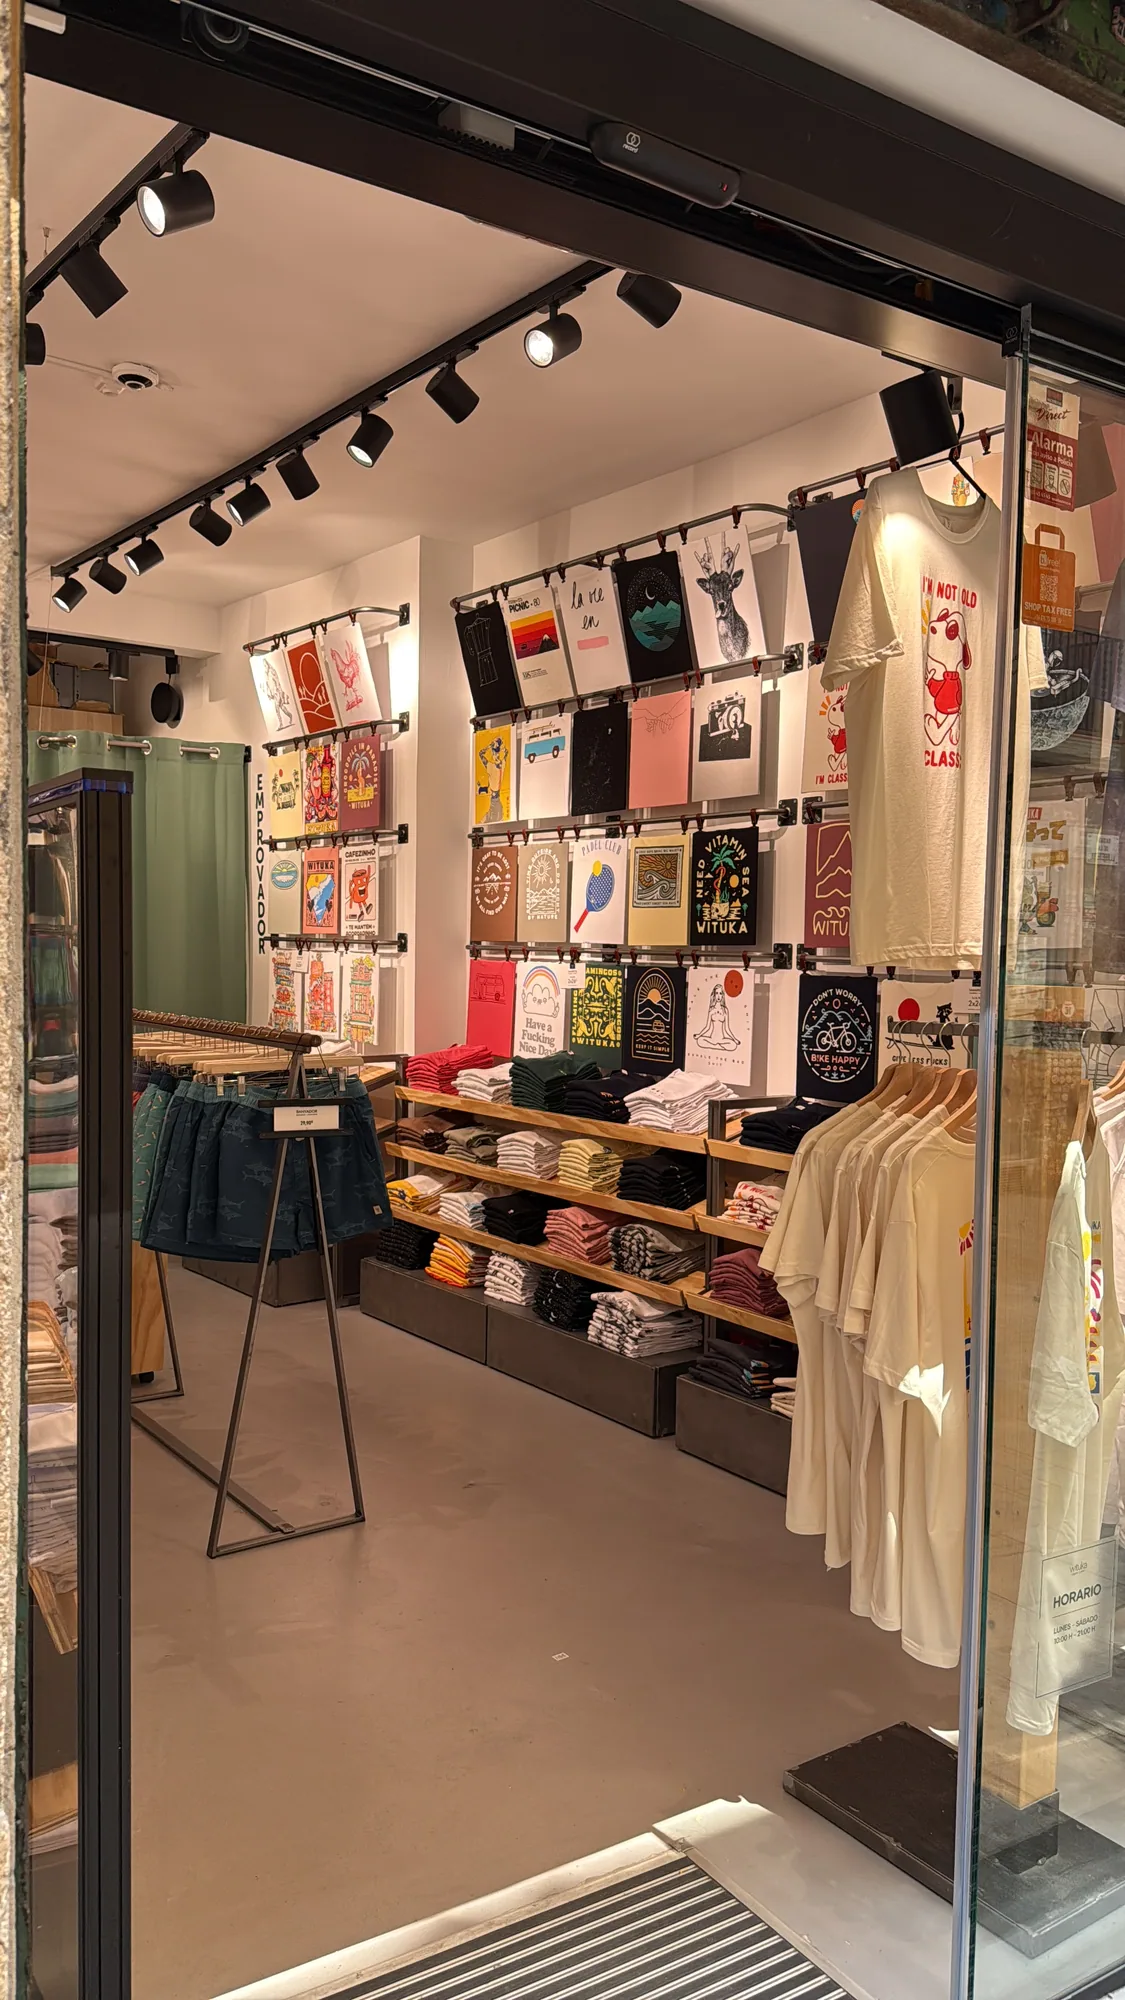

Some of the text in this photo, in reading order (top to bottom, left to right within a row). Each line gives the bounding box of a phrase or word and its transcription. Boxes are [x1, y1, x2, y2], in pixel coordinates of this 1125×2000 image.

[622, 143, 638, 154] record
[1037, 408, 1072, 420] Direct
[1032, 432, 1073, 458] Alarma
[570, 580, 584, 609] la
[923, 576, 977, 608] I'M NOT OLD
[508, 600, 529, 613] PICNIC
[1024, 601, 1072, 617] SHOP TAX FREE
[582, 615, 599, 630] en
[924, 750, 961, 769] CLASS
[816, 775, 824, 784] I'M
[345, 849, 376, 858] CAFEZINHO
[582, 840, 622, 856] PADEL CLUB
[255, 774, 266, 955] EMPROVADOR
[308, 862, 334, 870] WITUKA
[696, 835, 750, 898] NEED VITAMIN SEA
[696, 921, 748, 933] WITUKA
[813, 988, 862, 1007] DON'T WORRY
[526, 1018, 552, 1032] Have a
[522, 1029, 555, 1048] Fucking
[577, 1038, 615, 1048] WITUKA
[519, 1041, 536, 1054] Nice
[831, 1055, 860, 1065] HAPPY
[1053, 1584, 1102, 1608] HORARIO
[1053, 1623, 1071, 1634] LUNES
[1076, 1614, 1098, 1627] SÁBADO
[1053, 1635, 1067, 1644] 10:00
[1077, 1627, 1091, 1637] 21:00
